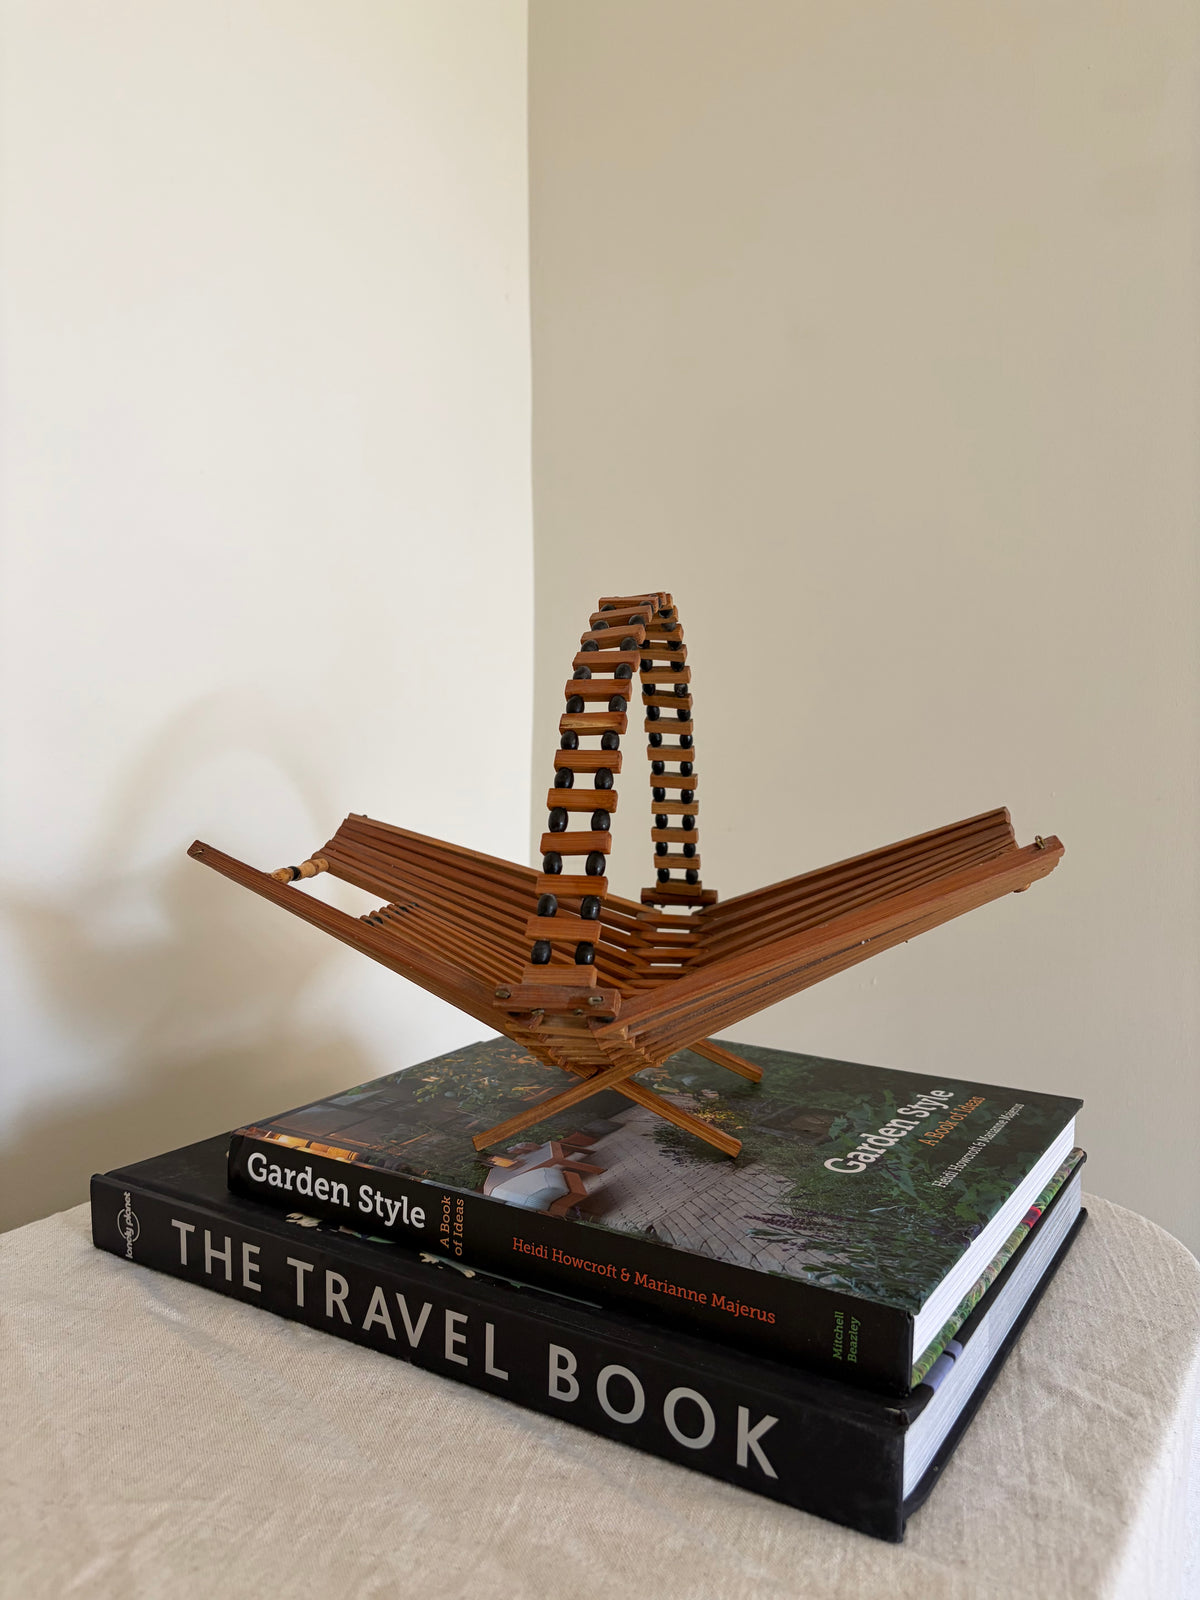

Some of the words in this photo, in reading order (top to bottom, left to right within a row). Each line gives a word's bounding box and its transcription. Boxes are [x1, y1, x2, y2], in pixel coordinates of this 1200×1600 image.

[950, 1111, 967, 1121] of
[953, 1096, 986, 1113] Ideas
[823, 1118, 920, 1174] Garden
[897, 1089, 955, 1118] Style
[918, 1138, 939, 1147] A
[924, 1120, 959, 1139] Book
[931, 1169, 959, 1188] Heidi
[948, 1145, 982, 1172] Howcroft
[123, 1191, 134, 1226] planet
[247, 1151, 350, 1208] Garden
[358, 1185, 426, 1229] Style
[440, 1195, 451, 1234] Book
[453, 1198, 465, 1238] Ideas
[125, 1227, 134, 1259] lonely
[440, 1237, 450, 1249] A
[453, 1239, 463, 1257] of
[512, 1237, 548, 1259] Heidi
[552, 1248, 617, 1279] Howcroft
[620, 1267, 631, 1282] &
[634, 1271, 708, 1304] Marianne
[711, 1293, 776, 1324] Majerus
[171, 1218, 262, 1293] THE
[286, 1256, 509, 1381] TRAVEL
[548, 1343, 780, 1480] BOOK
[832, 1311, 844, 1360] Mitchell
[847, 1316, 861, 1363] Beazley
